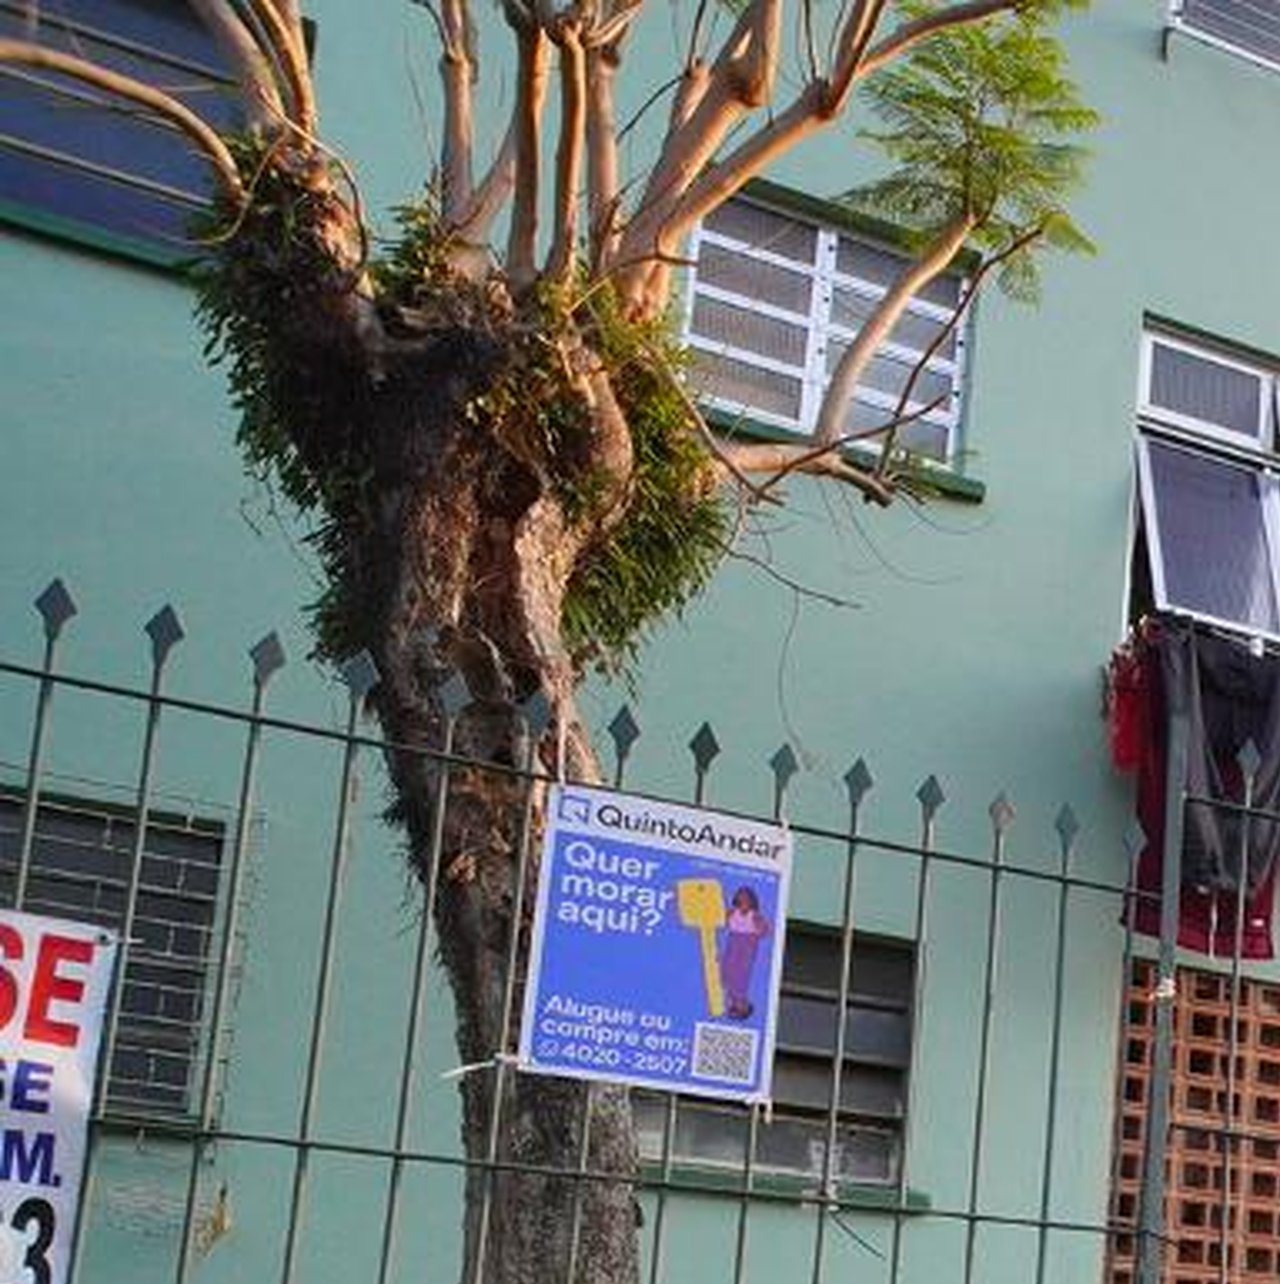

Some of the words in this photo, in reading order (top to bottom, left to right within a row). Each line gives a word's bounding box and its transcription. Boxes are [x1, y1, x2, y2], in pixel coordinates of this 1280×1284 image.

[597, 804, 784, 860] QuintoAndar
[565, 841, 660, 880] Quer
[561, 872, 673, 910] morar
[558, 900, 663, 935] aqui?
[544, 995, 634, 1027] Alugue
[640, 1011, 671, 1031] ou
[540, 1017, 640, 1047] compre
[644, 1034, 689, 1055] em:
